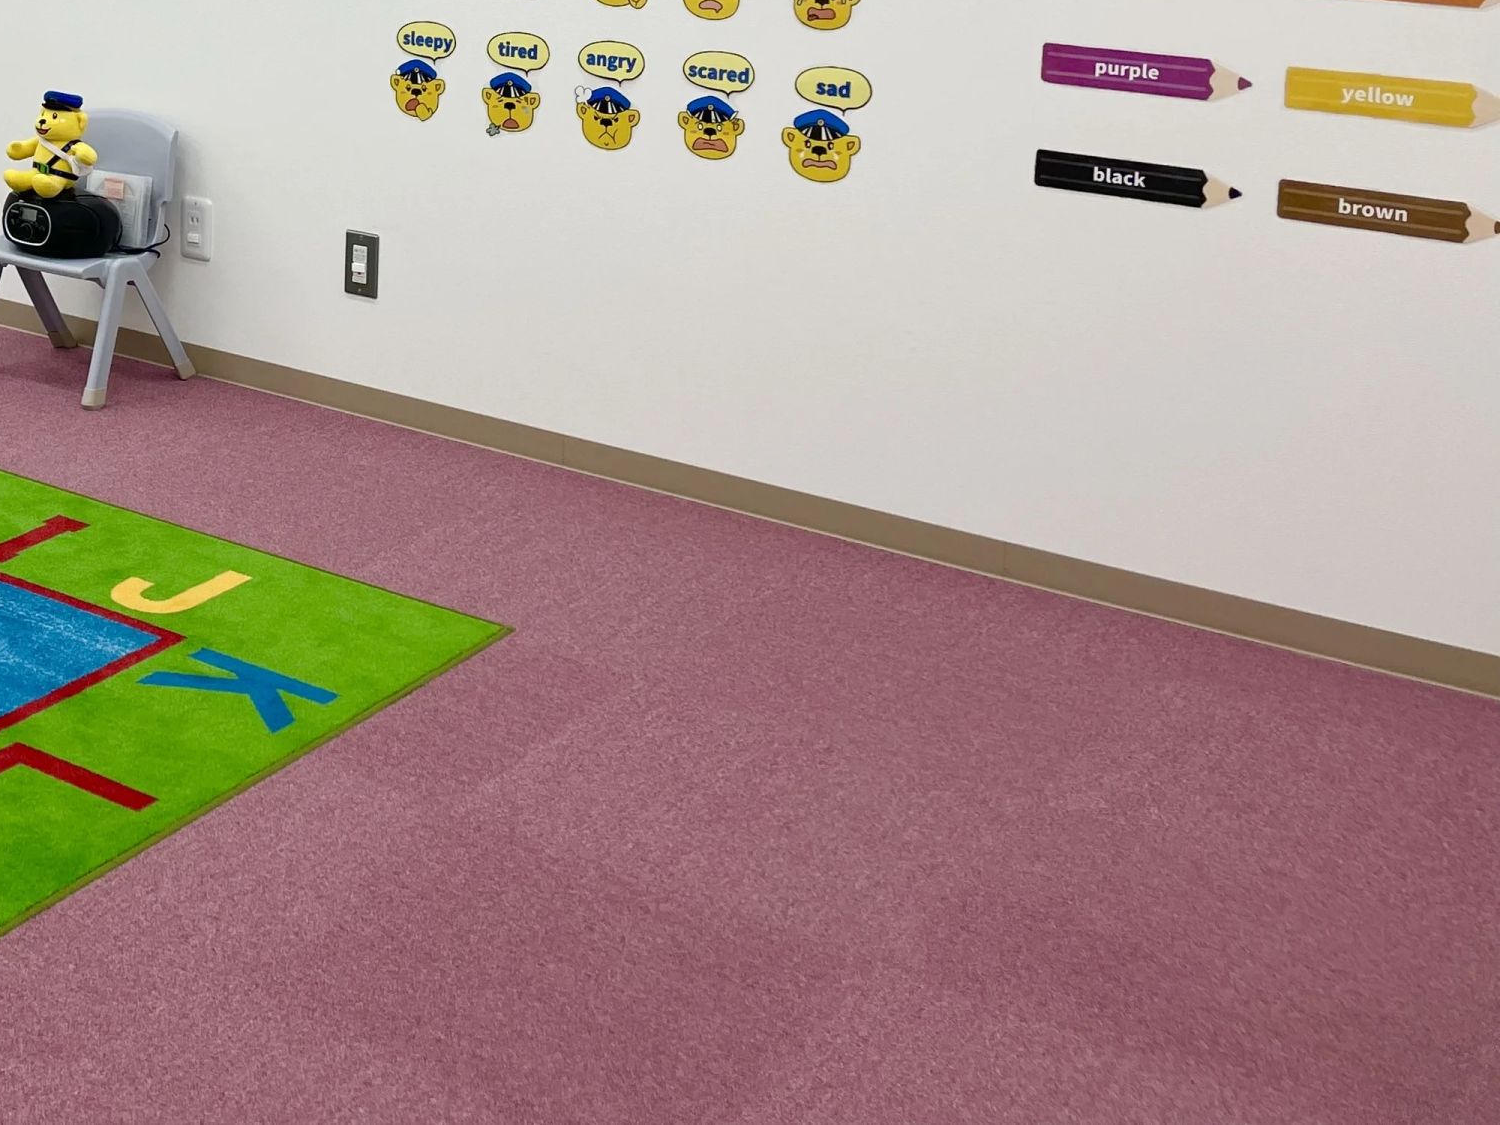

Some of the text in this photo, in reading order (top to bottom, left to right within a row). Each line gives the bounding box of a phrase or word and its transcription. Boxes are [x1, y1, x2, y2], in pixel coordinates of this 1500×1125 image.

[402, 31, 453, 53] sleepy
[498, 42, 538, 60] tired
[586, 52, 637, 73] angry
[1094, 61, 1160, 81] purple
[688, 64, 750, 85] scared
[816, 81, 851, 99] sad
[1341, 84, 1415, 107] yellow
[1092, 165, 1146, 188] black
[1337, 197, 1408, 222] brown
[110, 570, 252, 613] J
[137, 647, 340, 734] K
